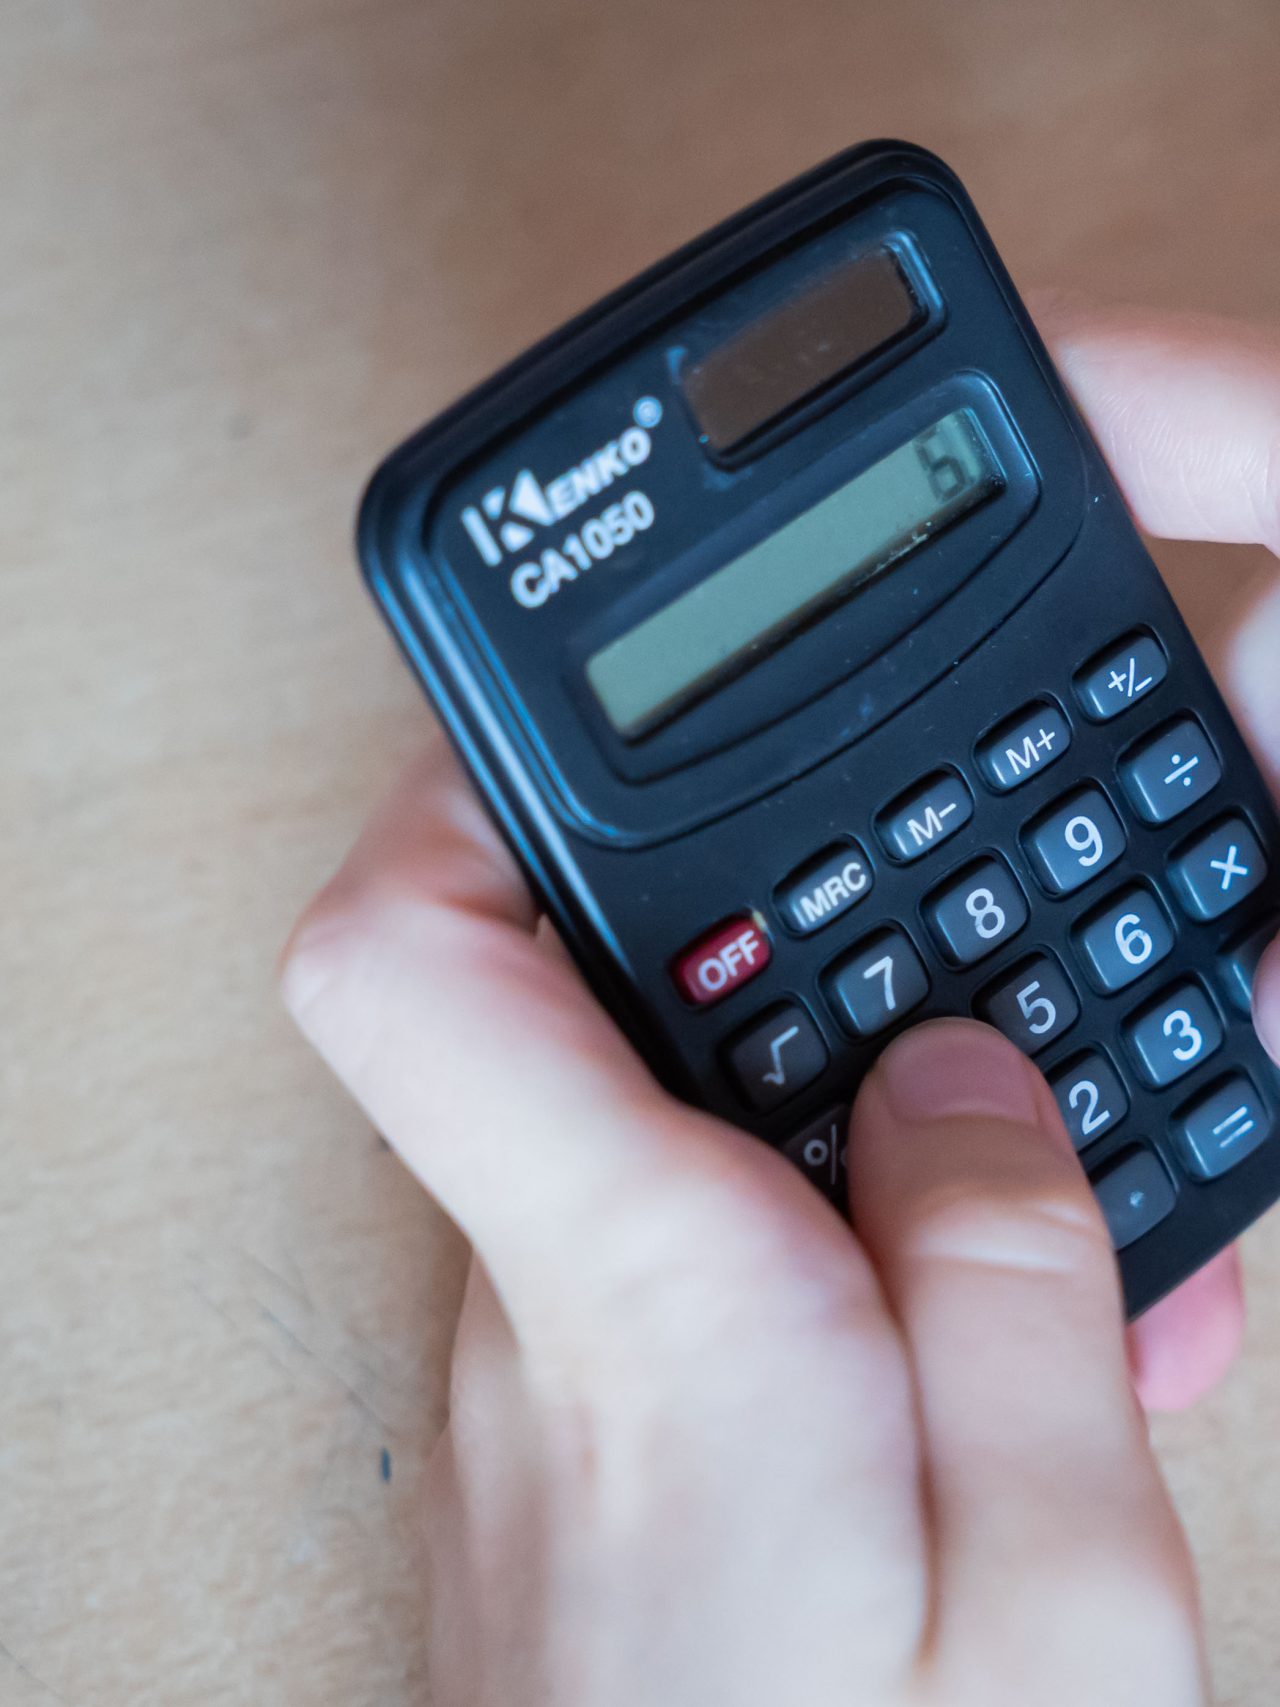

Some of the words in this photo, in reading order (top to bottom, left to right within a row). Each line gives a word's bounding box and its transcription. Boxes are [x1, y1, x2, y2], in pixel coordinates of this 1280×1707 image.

[461, 426, 650, 567] KENKO
[511, 491, 654, 608] CA1050
[698, 930, 759, 991] OFF
[800, 863, 866, 922] MRC
[1006, 729, 1055, 775] M+
[863, 956, 896, 1010] 7
[965, 888, 1005, 939] 8
[1065, 816, 1103, 867] 9
[1016, 981, 1056, 1034] 5
[1115, 914, 1152, 964] 6
[1068, 1080, 1111, 1135] 2
[1163, 1010, 1202, 1061] 3
